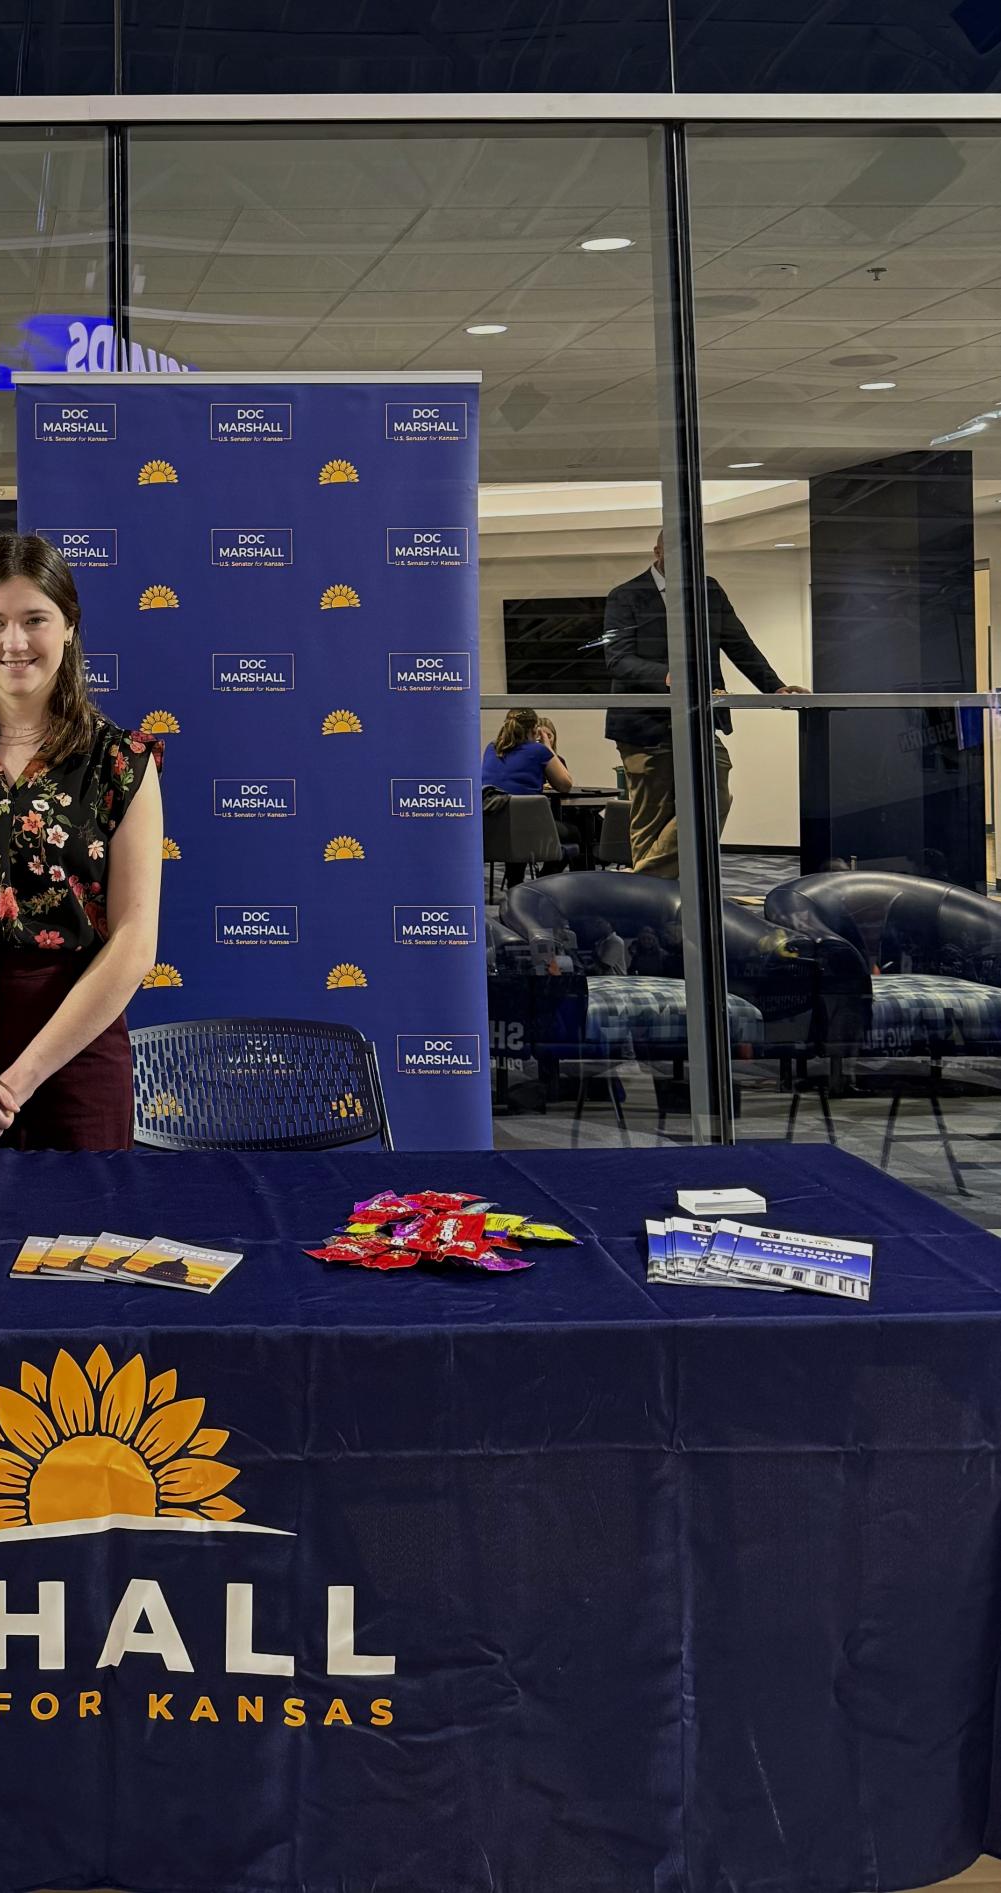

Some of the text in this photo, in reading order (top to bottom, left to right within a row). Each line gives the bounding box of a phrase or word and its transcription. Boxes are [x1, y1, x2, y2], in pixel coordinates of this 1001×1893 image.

[62, 410, 89, 419] DOC
[238, 410, 264, 419] DOC
[413, 409, 440, 418] DOC
[44, 423, 108, 432] MARSHALL
[219, 423, 283, 432] MARSHALL
[395, 422, 459, 431] MARSHALL
[64, 535, 90, 544] DOC
[239, 535, 265, 544] DOC
[414, 534, 441, 543] DOC
[58, 548, 109, 558] ARSHALL
[220, 548, 285, 557] MARSHALL
[396, 547, 461, 556] MARSHALL
[240, 660, 267, 669] DOC
[417, 659, 444, 668] DOC
[221, 673, 286, 682] MARSHALL
[398, 672, 463, 681] MARSHALL
[242, 786, 268, 794] DOC
[419, 785, 446, 794] DOC
[223, 799, 288, 808] MARSHALL
[400, 798, 466, 807] MARSHALL
[243, 912, 270, 921] DOC
[422, 912, 449, 921] DOC
[224, 926, 290, 935] MARSHALL
[403, 926, 469, 935] MARSHALL
[425, 1041, 453, 1051] DOC
[406, 1055, 473, 1064] MARSHALL
[755, 1241, 853, 1260] INTERNSHIP
[762, 1246, 844, 1264] PROGRAM
[148, 1693, 394, 1727] KANSAS
